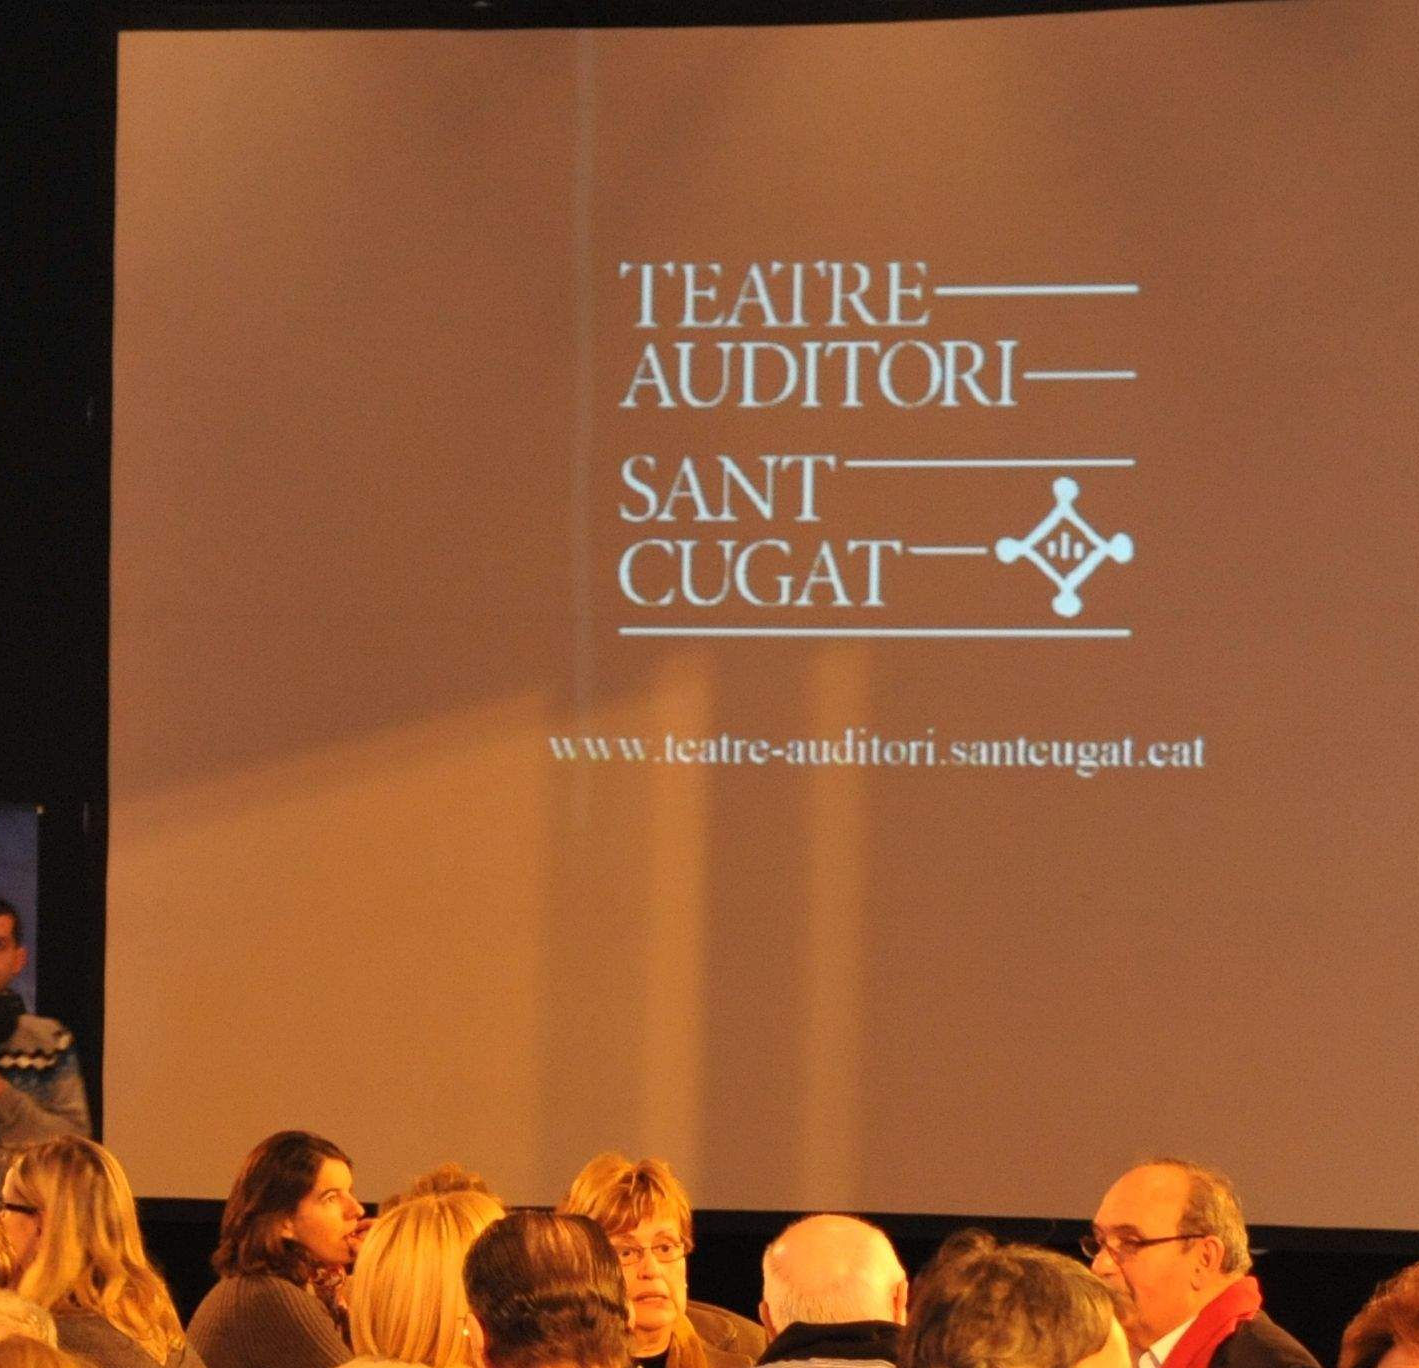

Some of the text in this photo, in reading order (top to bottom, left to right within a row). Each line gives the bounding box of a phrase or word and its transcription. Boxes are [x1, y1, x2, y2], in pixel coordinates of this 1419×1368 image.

[619, 262, 933, 329] TEATRE
[619, 340, 1018, 409] AUDITORI
[619, 455, 836, 522] SANT
[619, 538, 902, 608] CUGAT
[549, 728, 1207, 779] www.teatre-auditori.santcugat.cat
